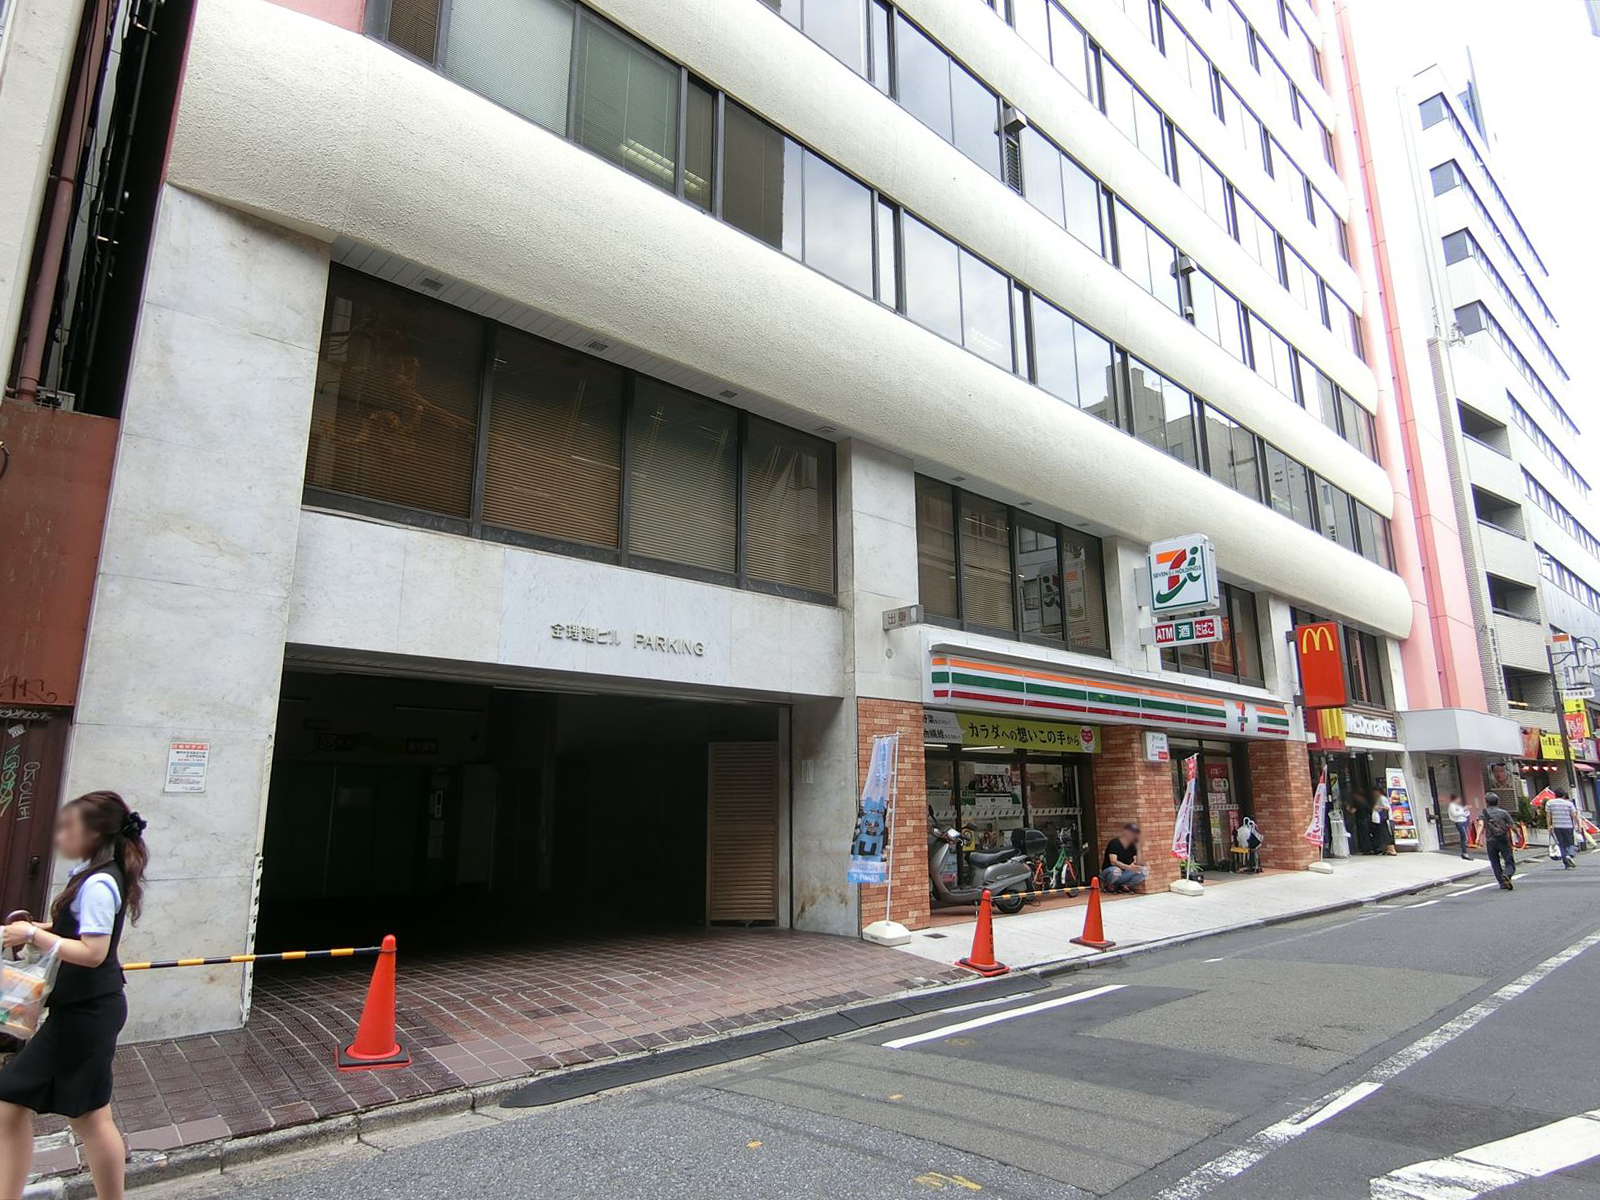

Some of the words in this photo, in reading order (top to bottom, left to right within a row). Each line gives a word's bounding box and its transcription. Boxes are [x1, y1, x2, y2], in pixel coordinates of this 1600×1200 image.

[1175, 564, 1202, 574] HOLDINGS
[1156, 626, 1173, 640] ATM
[1178, 625, 1191, 639] 酒
[1195, 622, 1214, 637] たばこ
[633, 631, 704, 657] PARKING
[968, 722, 1080, 746] カラダへの想いこの手から
